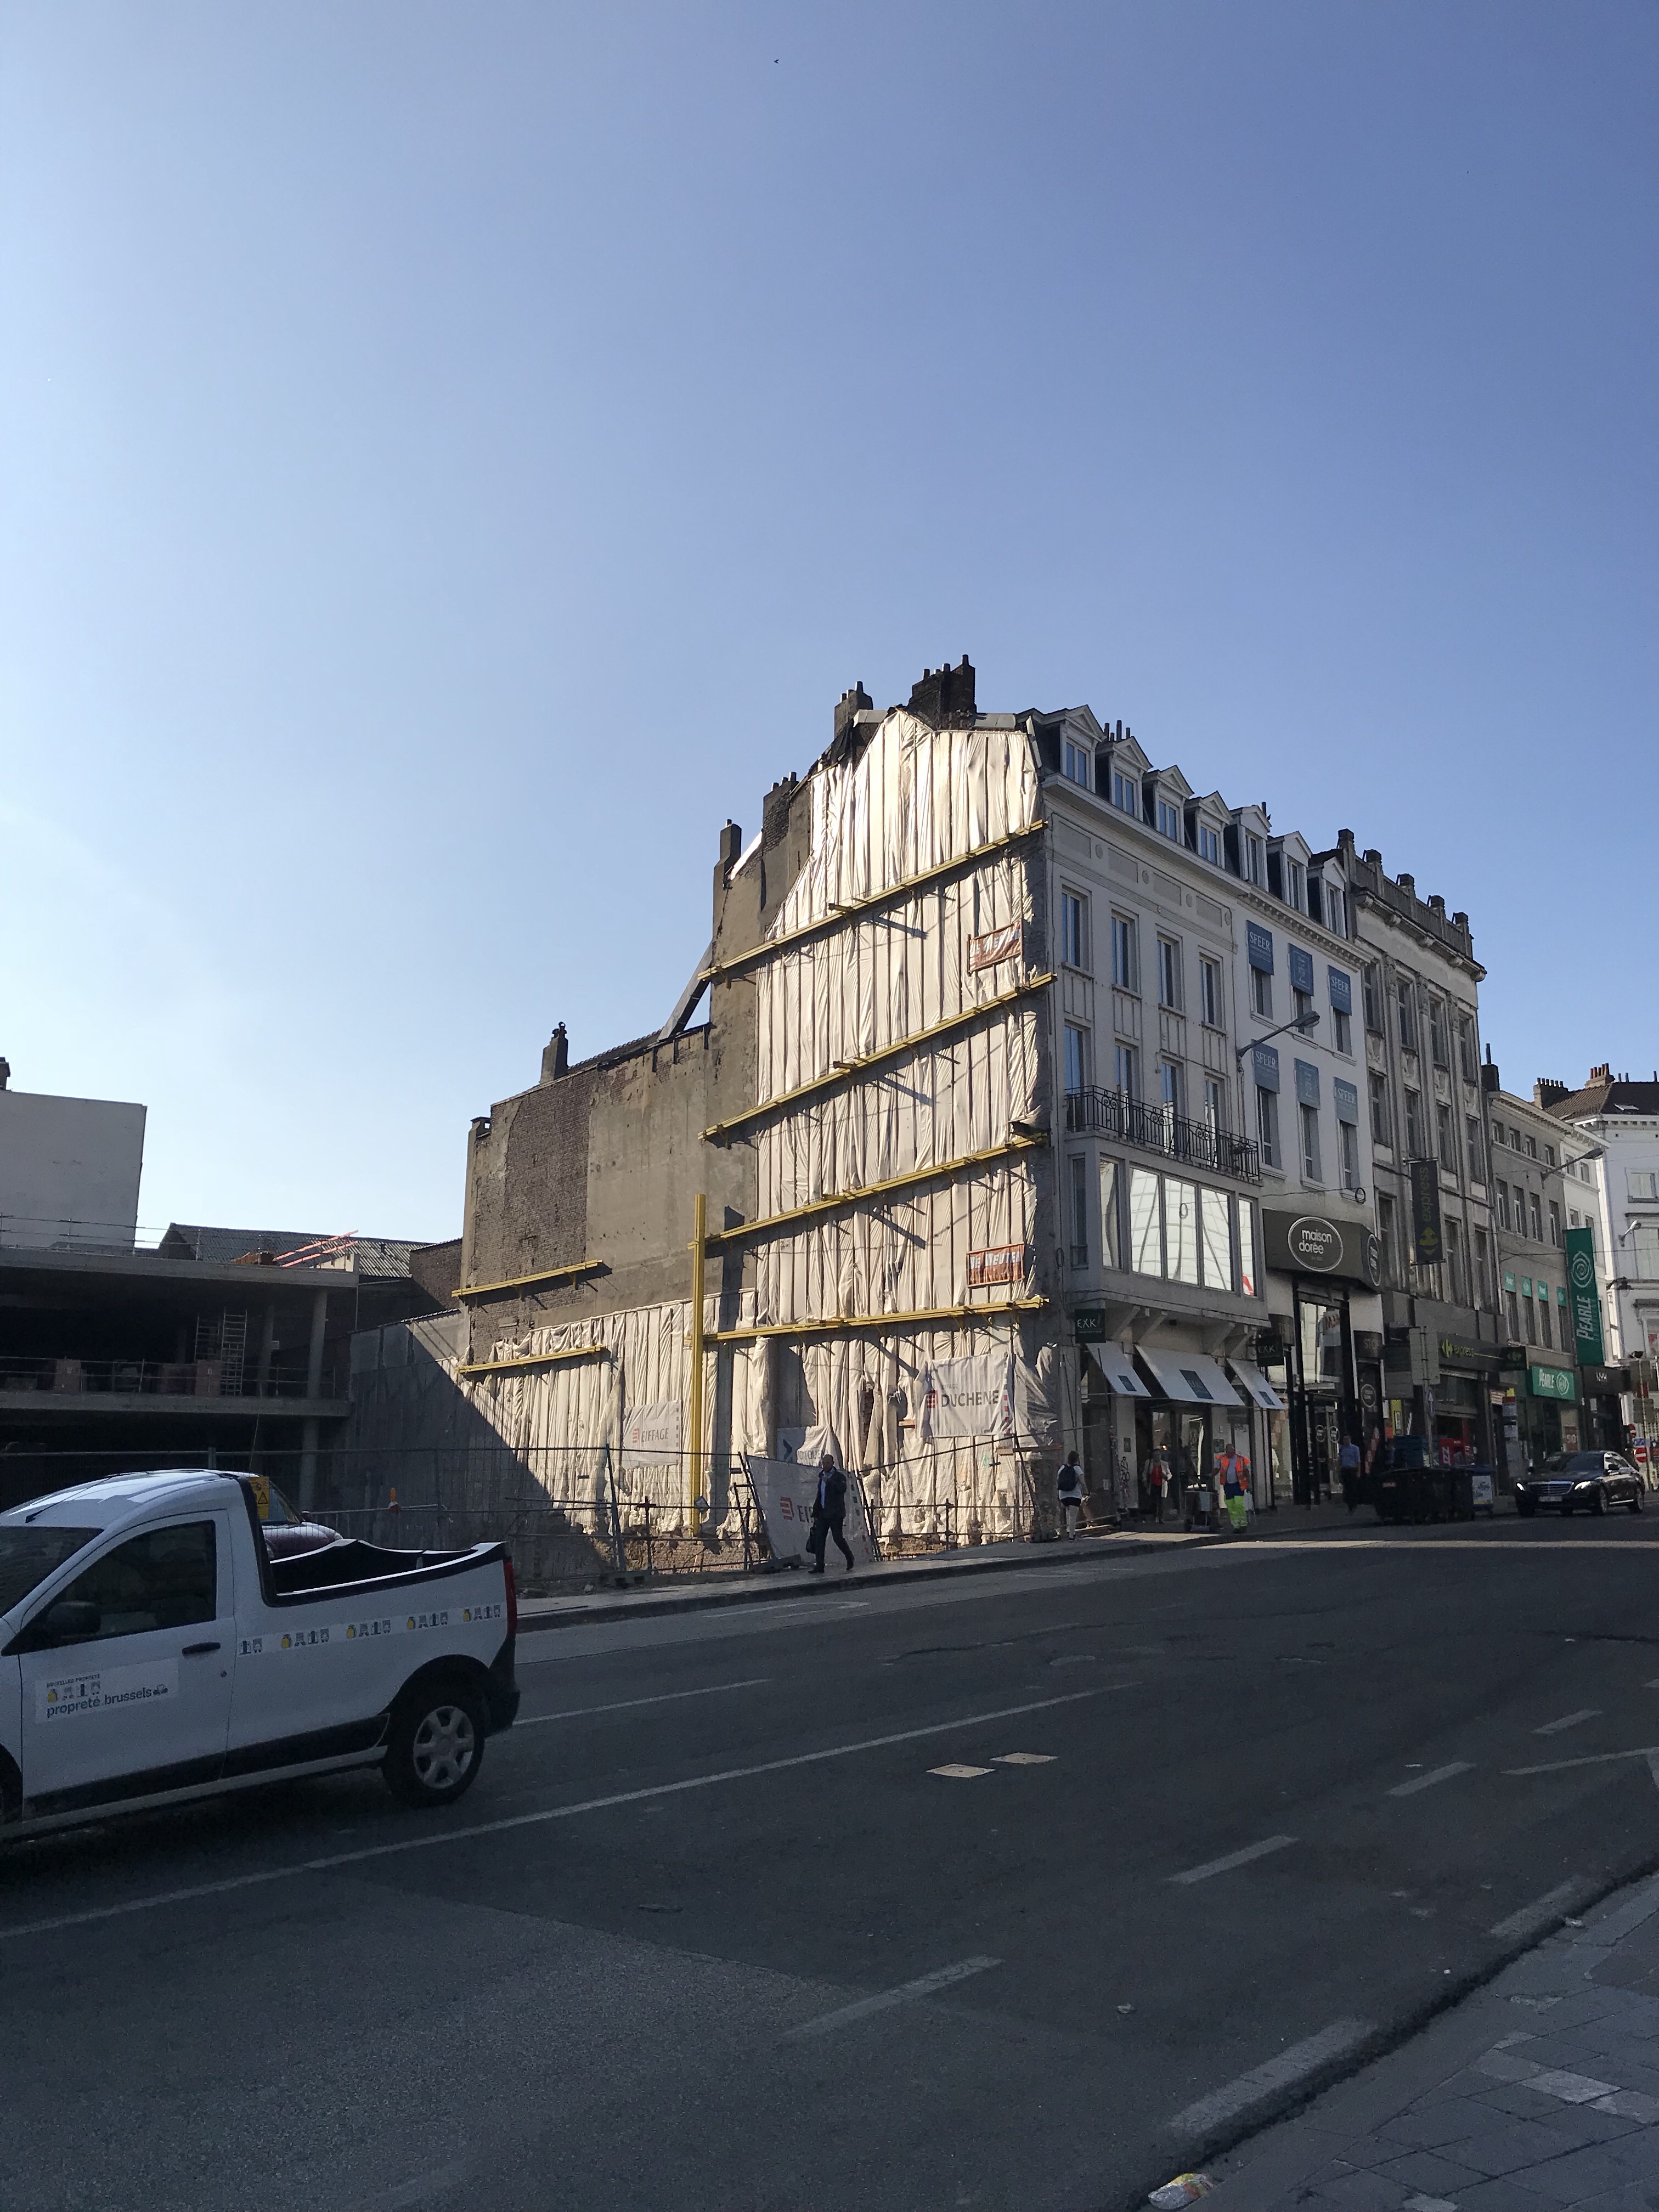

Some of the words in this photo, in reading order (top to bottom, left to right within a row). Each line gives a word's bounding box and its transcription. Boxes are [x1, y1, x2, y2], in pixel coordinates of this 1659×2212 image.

[1250, 932, 1271, 952] SFEER
[1331, 977, 1349, 994] SFEER
[1255, 1051, 1276, 1069] SFEER
[1337, 1087, 1355, 1104] SFEER
[1420, 1167, 1433, 1222] express
[1302, 1229, 1333, 1243] maison
[1299, 1240, 1324, 1254] dorée
[1577, 1295, 1594, 1340] PEARLE
[1539, 1369, 1555, 1389] PEARLE
[941, 1390, 999, 1408] DUCHENE
[641, 1427, 669, 1442] EIFFAGE
